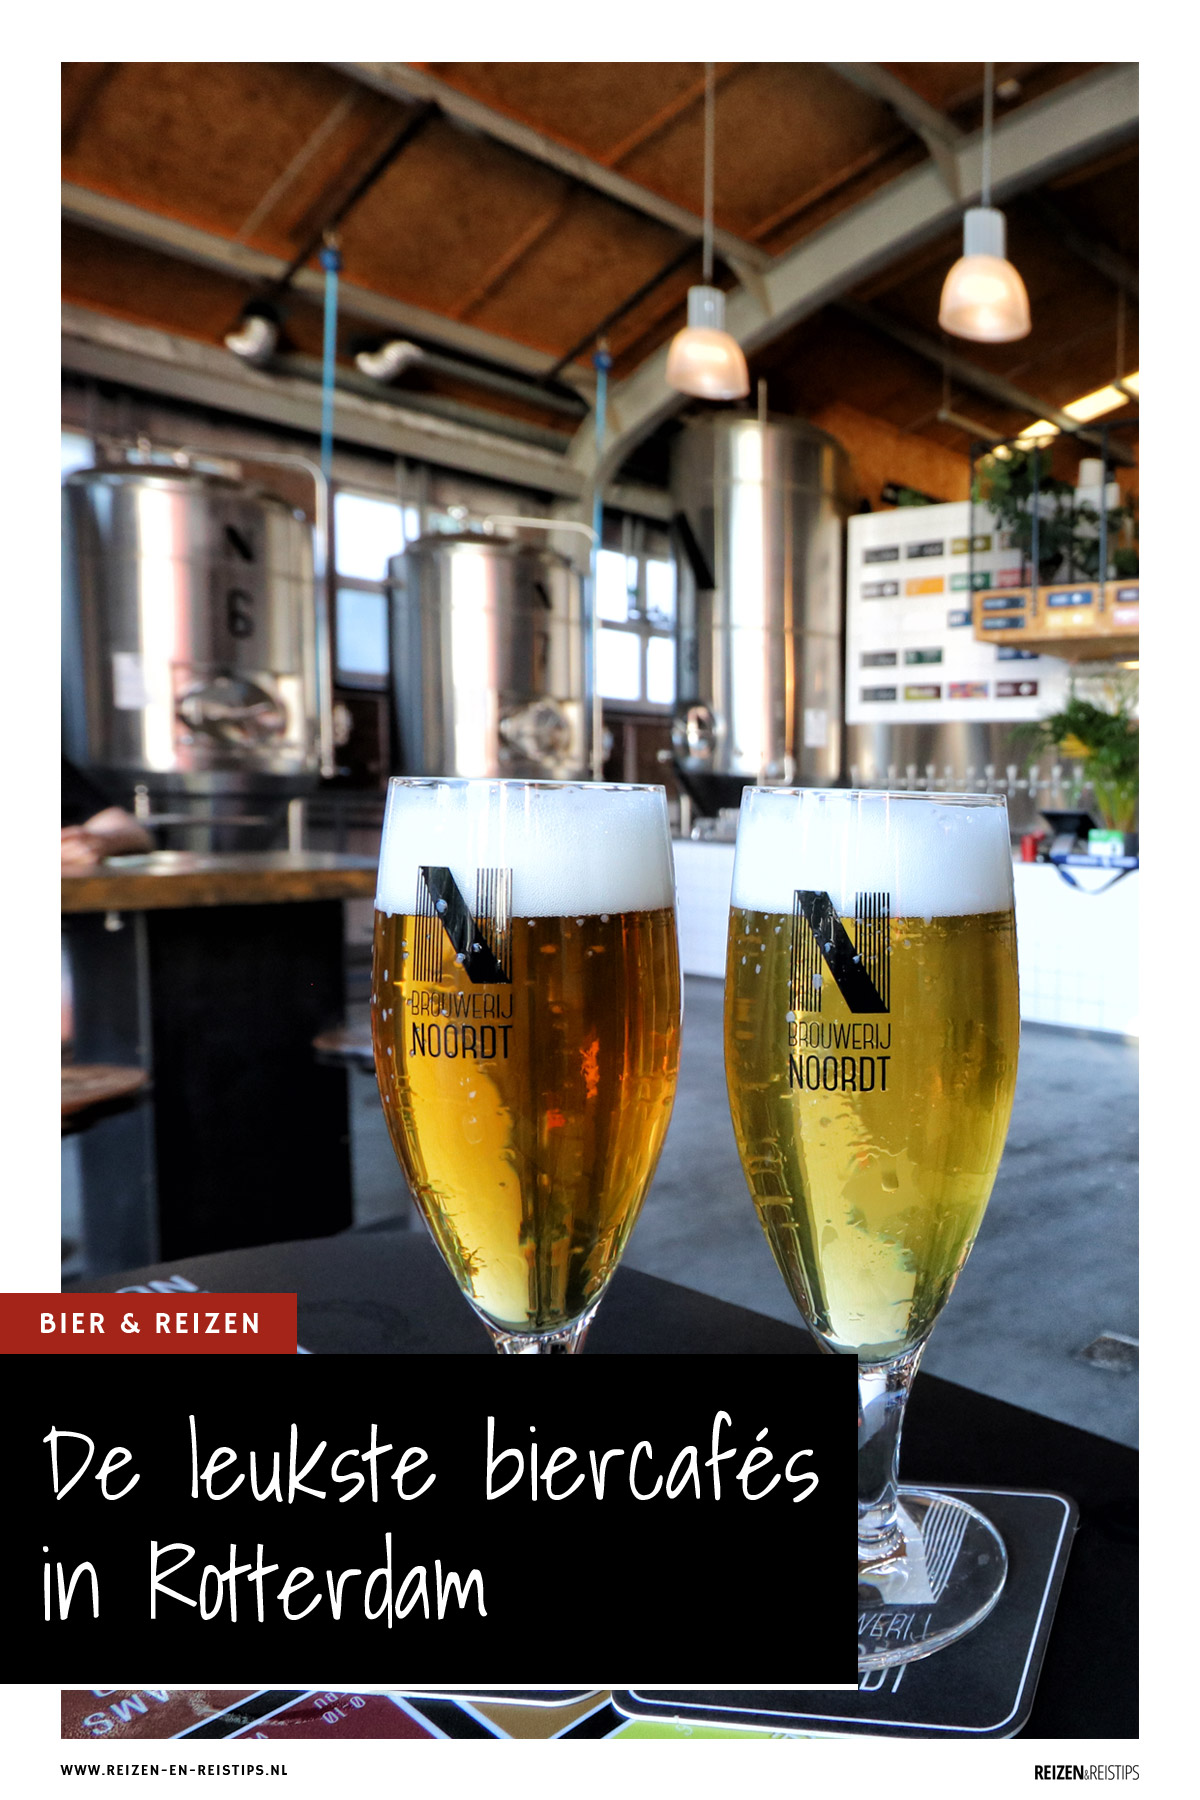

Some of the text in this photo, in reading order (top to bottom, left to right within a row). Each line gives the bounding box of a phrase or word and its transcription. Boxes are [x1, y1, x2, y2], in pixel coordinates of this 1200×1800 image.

[411, 990, 513, 1019] BROUWERIJ
[411, 1021, 513, 1059] NOORDT
[788, 1021, 892, 1050] BROUWERIJ
[789, 1053, 892, 1092] NOORDT
